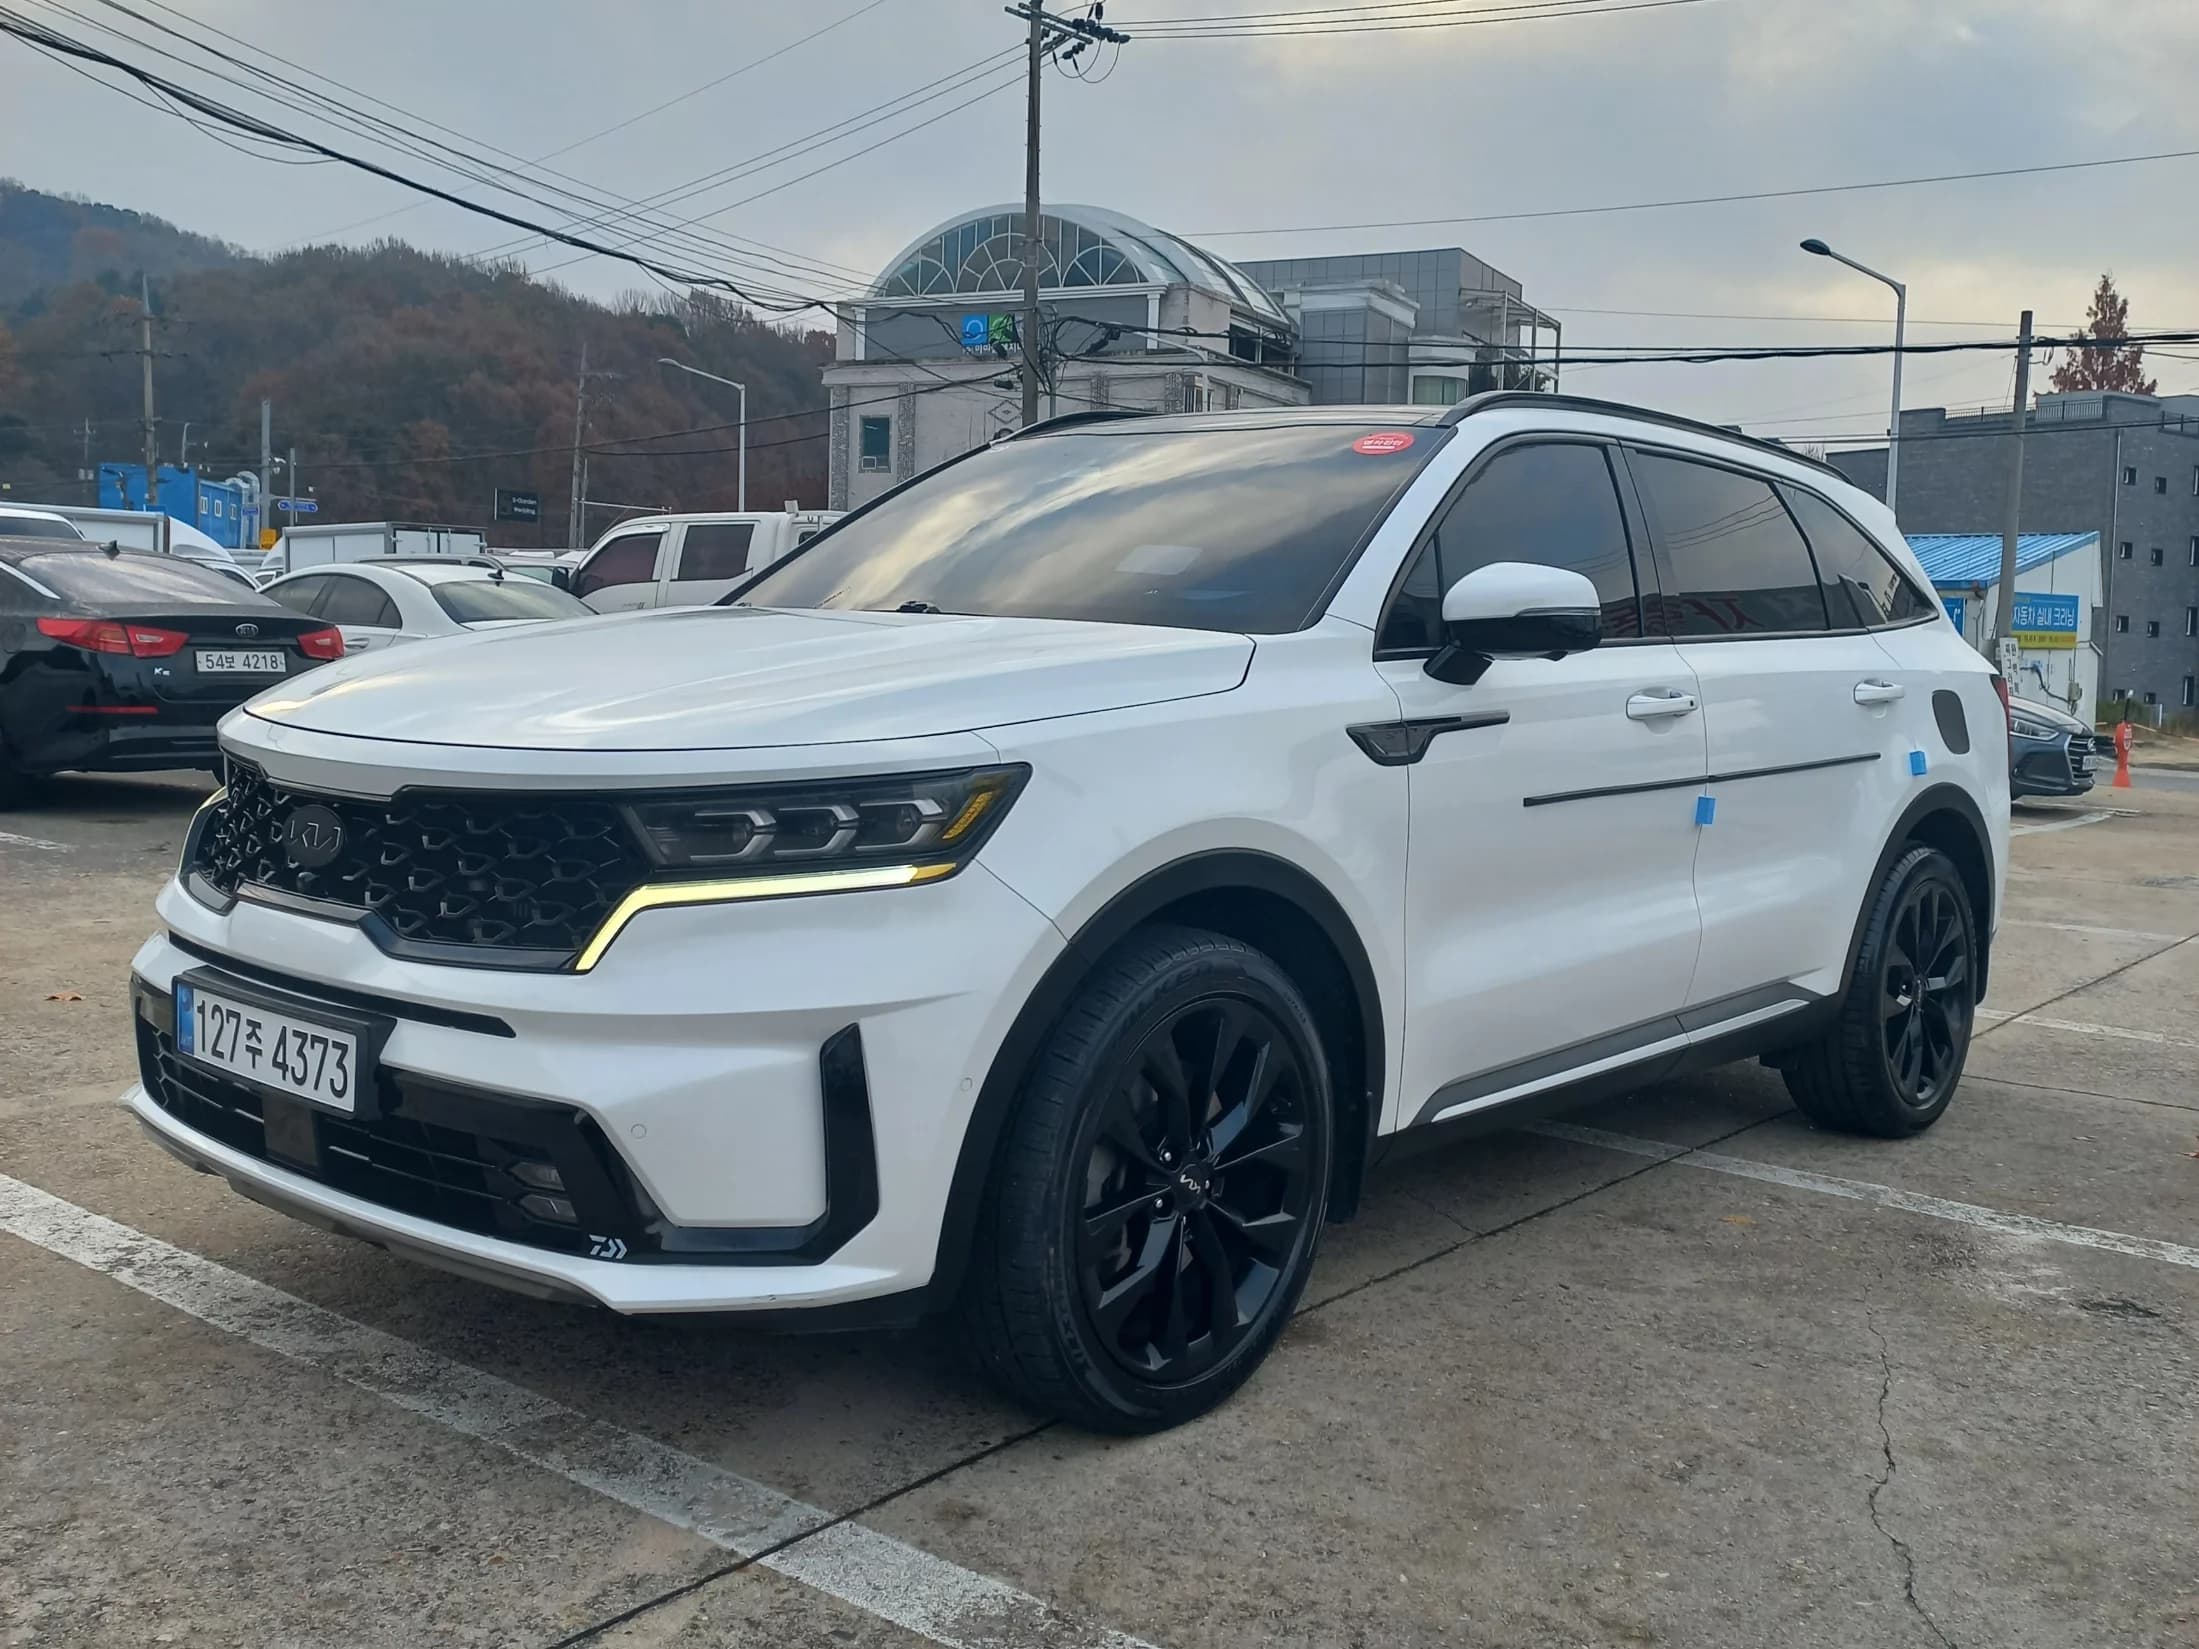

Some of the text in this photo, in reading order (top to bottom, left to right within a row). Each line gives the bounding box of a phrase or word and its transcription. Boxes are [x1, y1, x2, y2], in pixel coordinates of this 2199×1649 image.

[2037, 607, 2052, 626] 실내
[205, 653, 279, 670] 54보 4218
[196, 999, 350, 1099] 127주 4373
